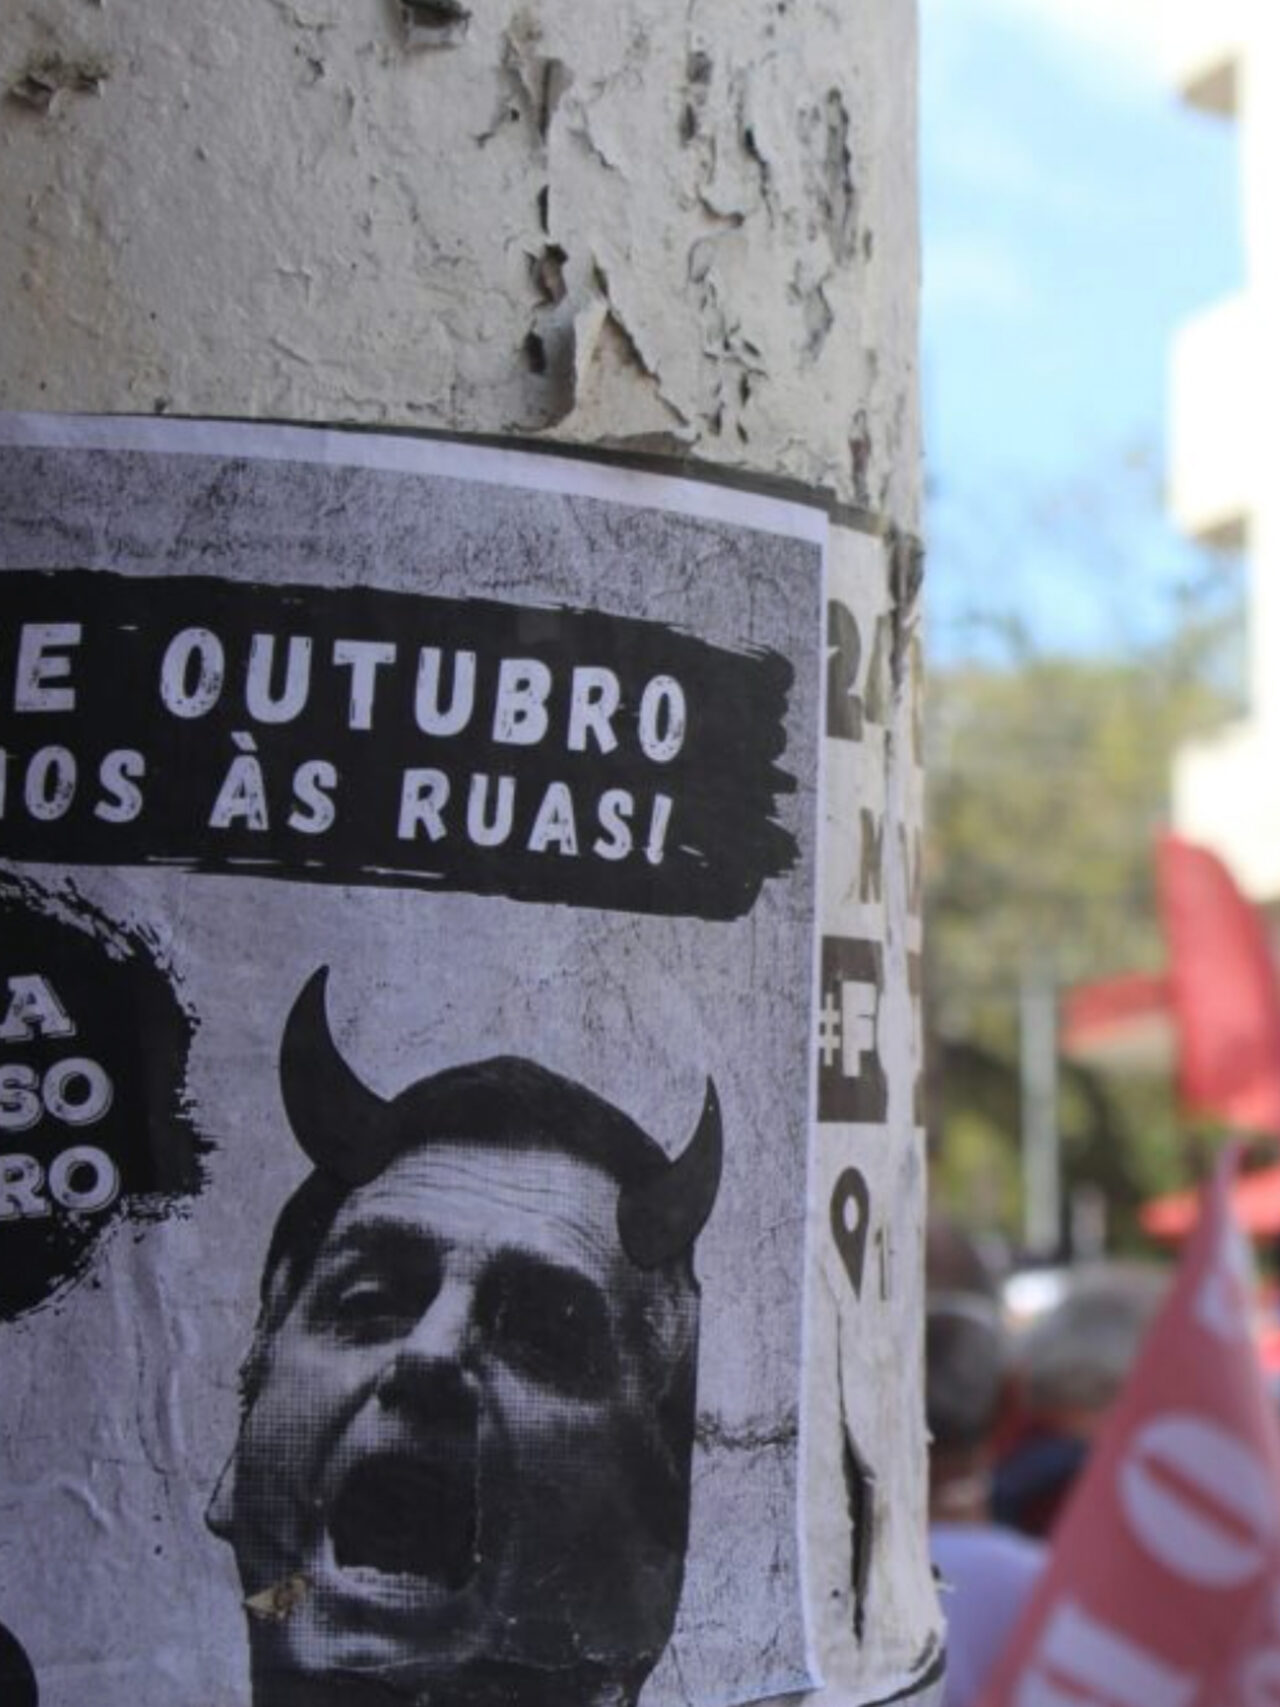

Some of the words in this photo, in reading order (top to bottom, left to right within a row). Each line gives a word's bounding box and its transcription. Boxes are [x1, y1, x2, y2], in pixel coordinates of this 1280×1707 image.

[159, 626, 688, 764] OUTUBRO
[208, 731, 339, 835] ÀS
[397, 767, 675, 866] RUAS!
